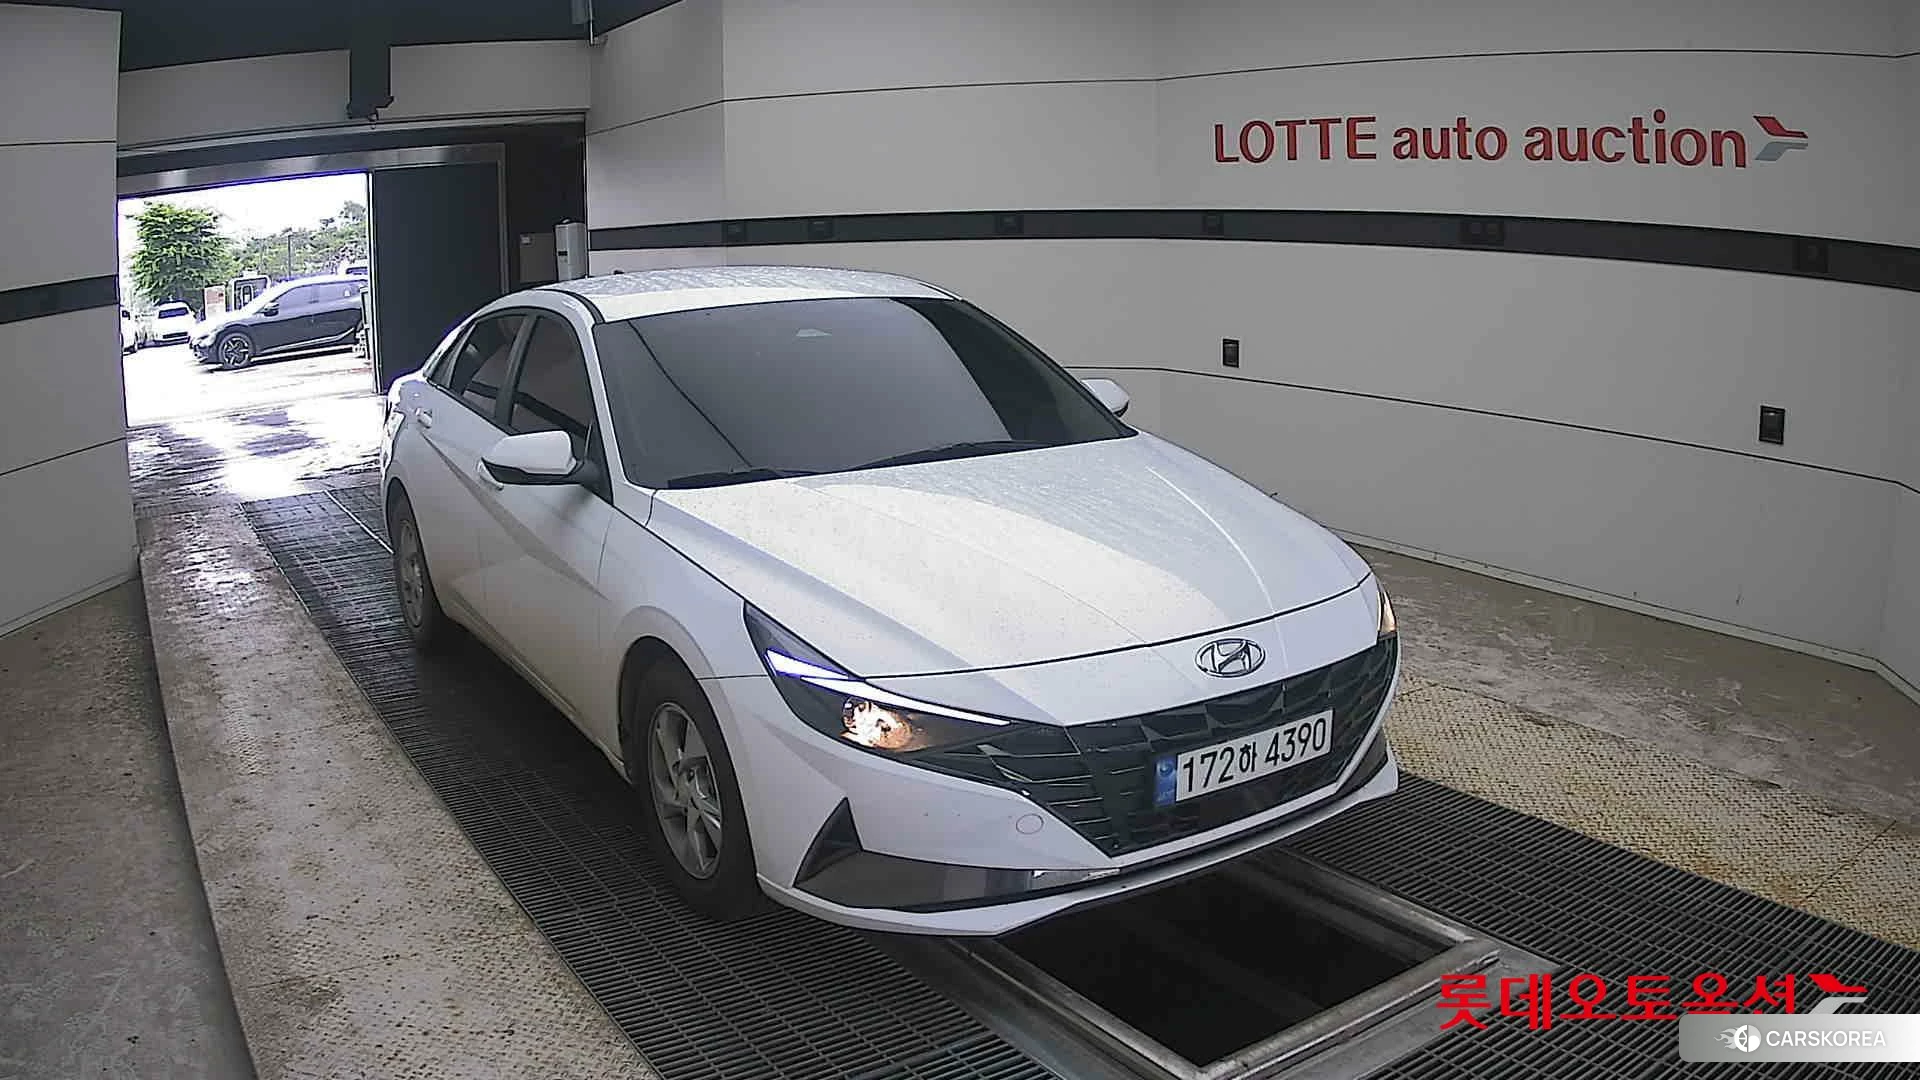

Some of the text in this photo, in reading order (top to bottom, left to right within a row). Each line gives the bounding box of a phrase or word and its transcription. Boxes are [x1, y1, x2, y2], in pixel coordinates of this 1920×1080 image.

[1213, 109, 1747, 169] LOTTE auto auction
[1183, 717, 1327, 793] 172하 4390
